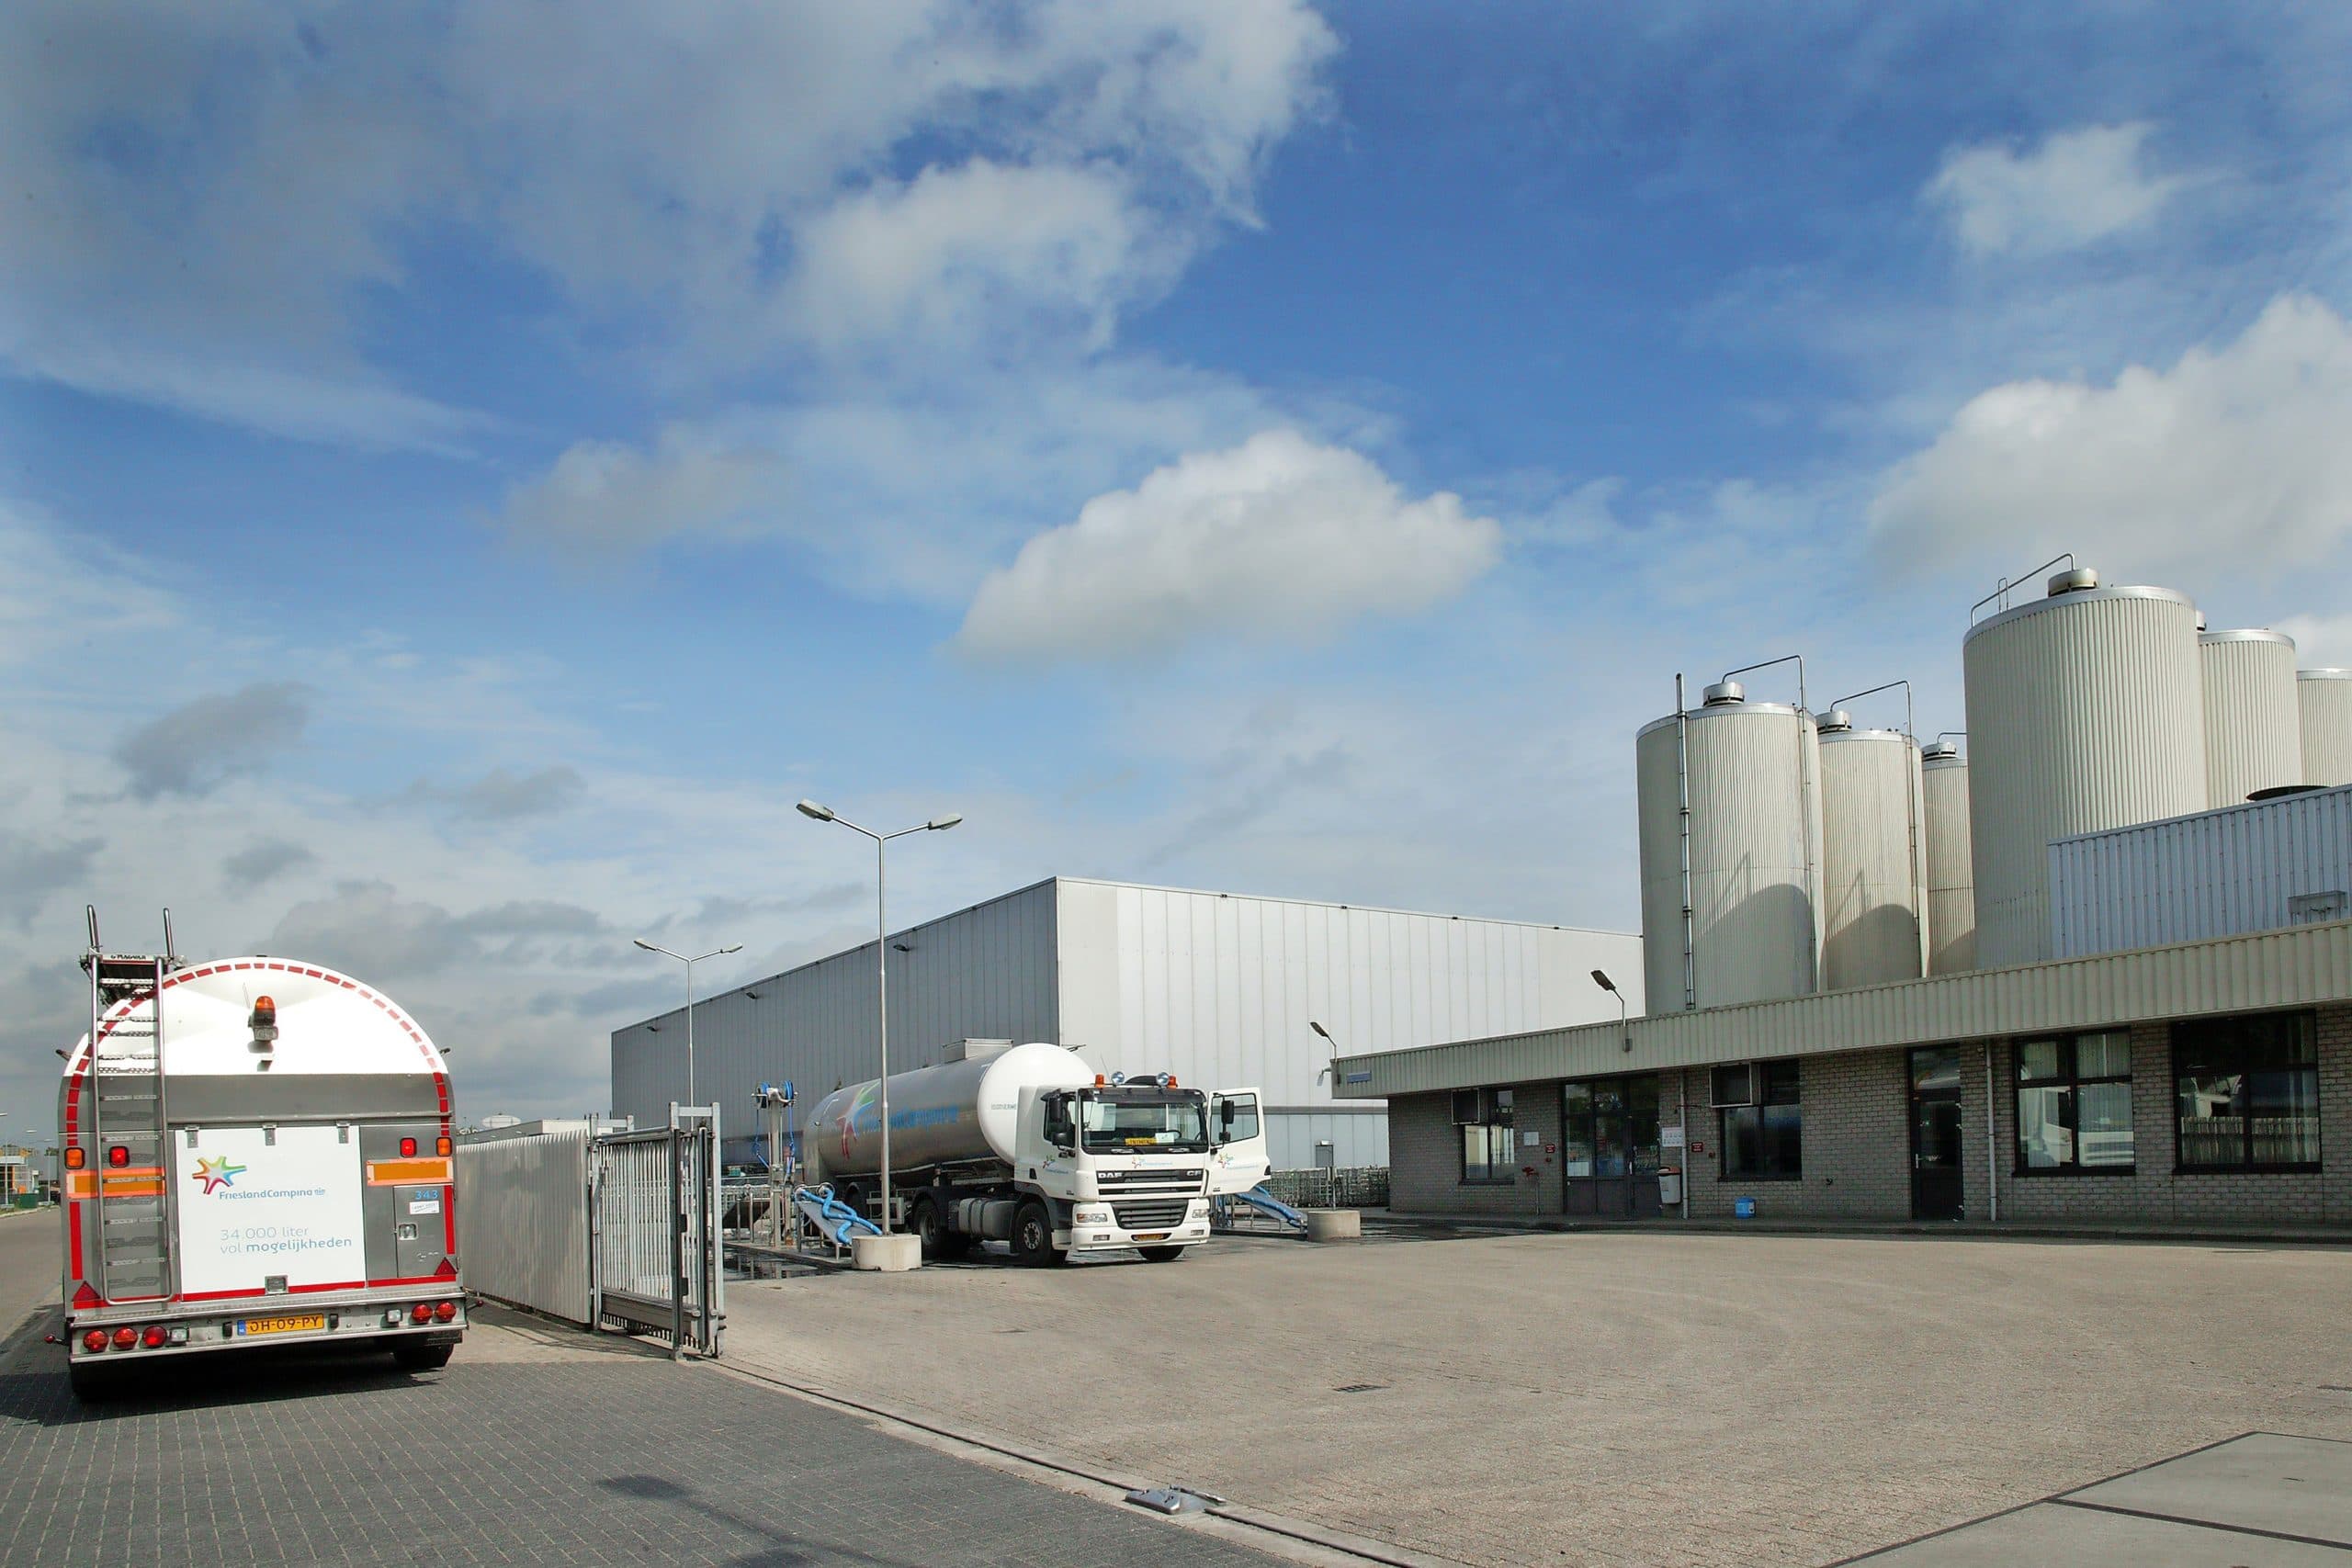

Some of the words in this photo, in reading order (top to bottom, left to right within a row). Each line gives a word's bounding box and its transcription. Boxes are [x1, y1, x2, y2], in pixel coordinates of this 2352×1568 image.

[219, 1189, 312, 1200] FrieslandCampina
[281, 1226, 309, 1237] liter
[220, 1242, 242, 1255] vol
[246, 1237, 352, 1254] mogelijkheden
